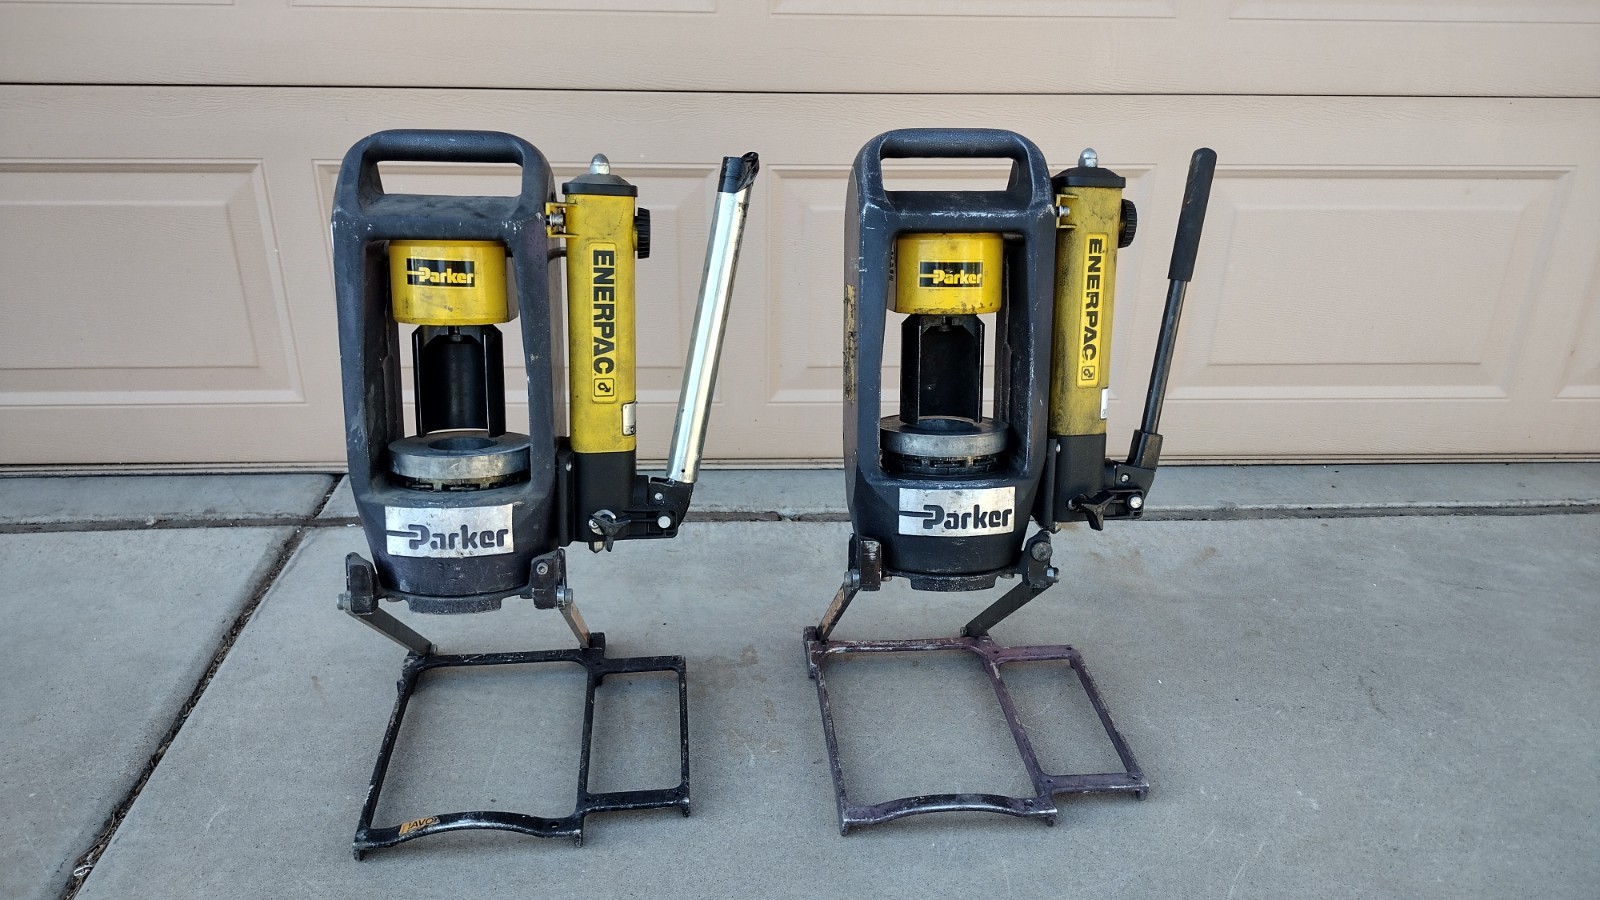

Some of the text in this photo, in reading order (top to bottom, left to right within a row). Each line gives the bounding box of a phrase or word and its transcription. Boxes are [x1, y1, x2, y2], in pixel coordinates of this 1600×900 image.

[418, 266, 474, 284] Parker
[932, 269, 982, 285] Parker
[593, 250, 615, 375] ENERPAC
[1082, 238, 1103, 361] ENERPAC
[923, 504, 1013, 530] Parker
[408, 523, 509, 550] Parker
